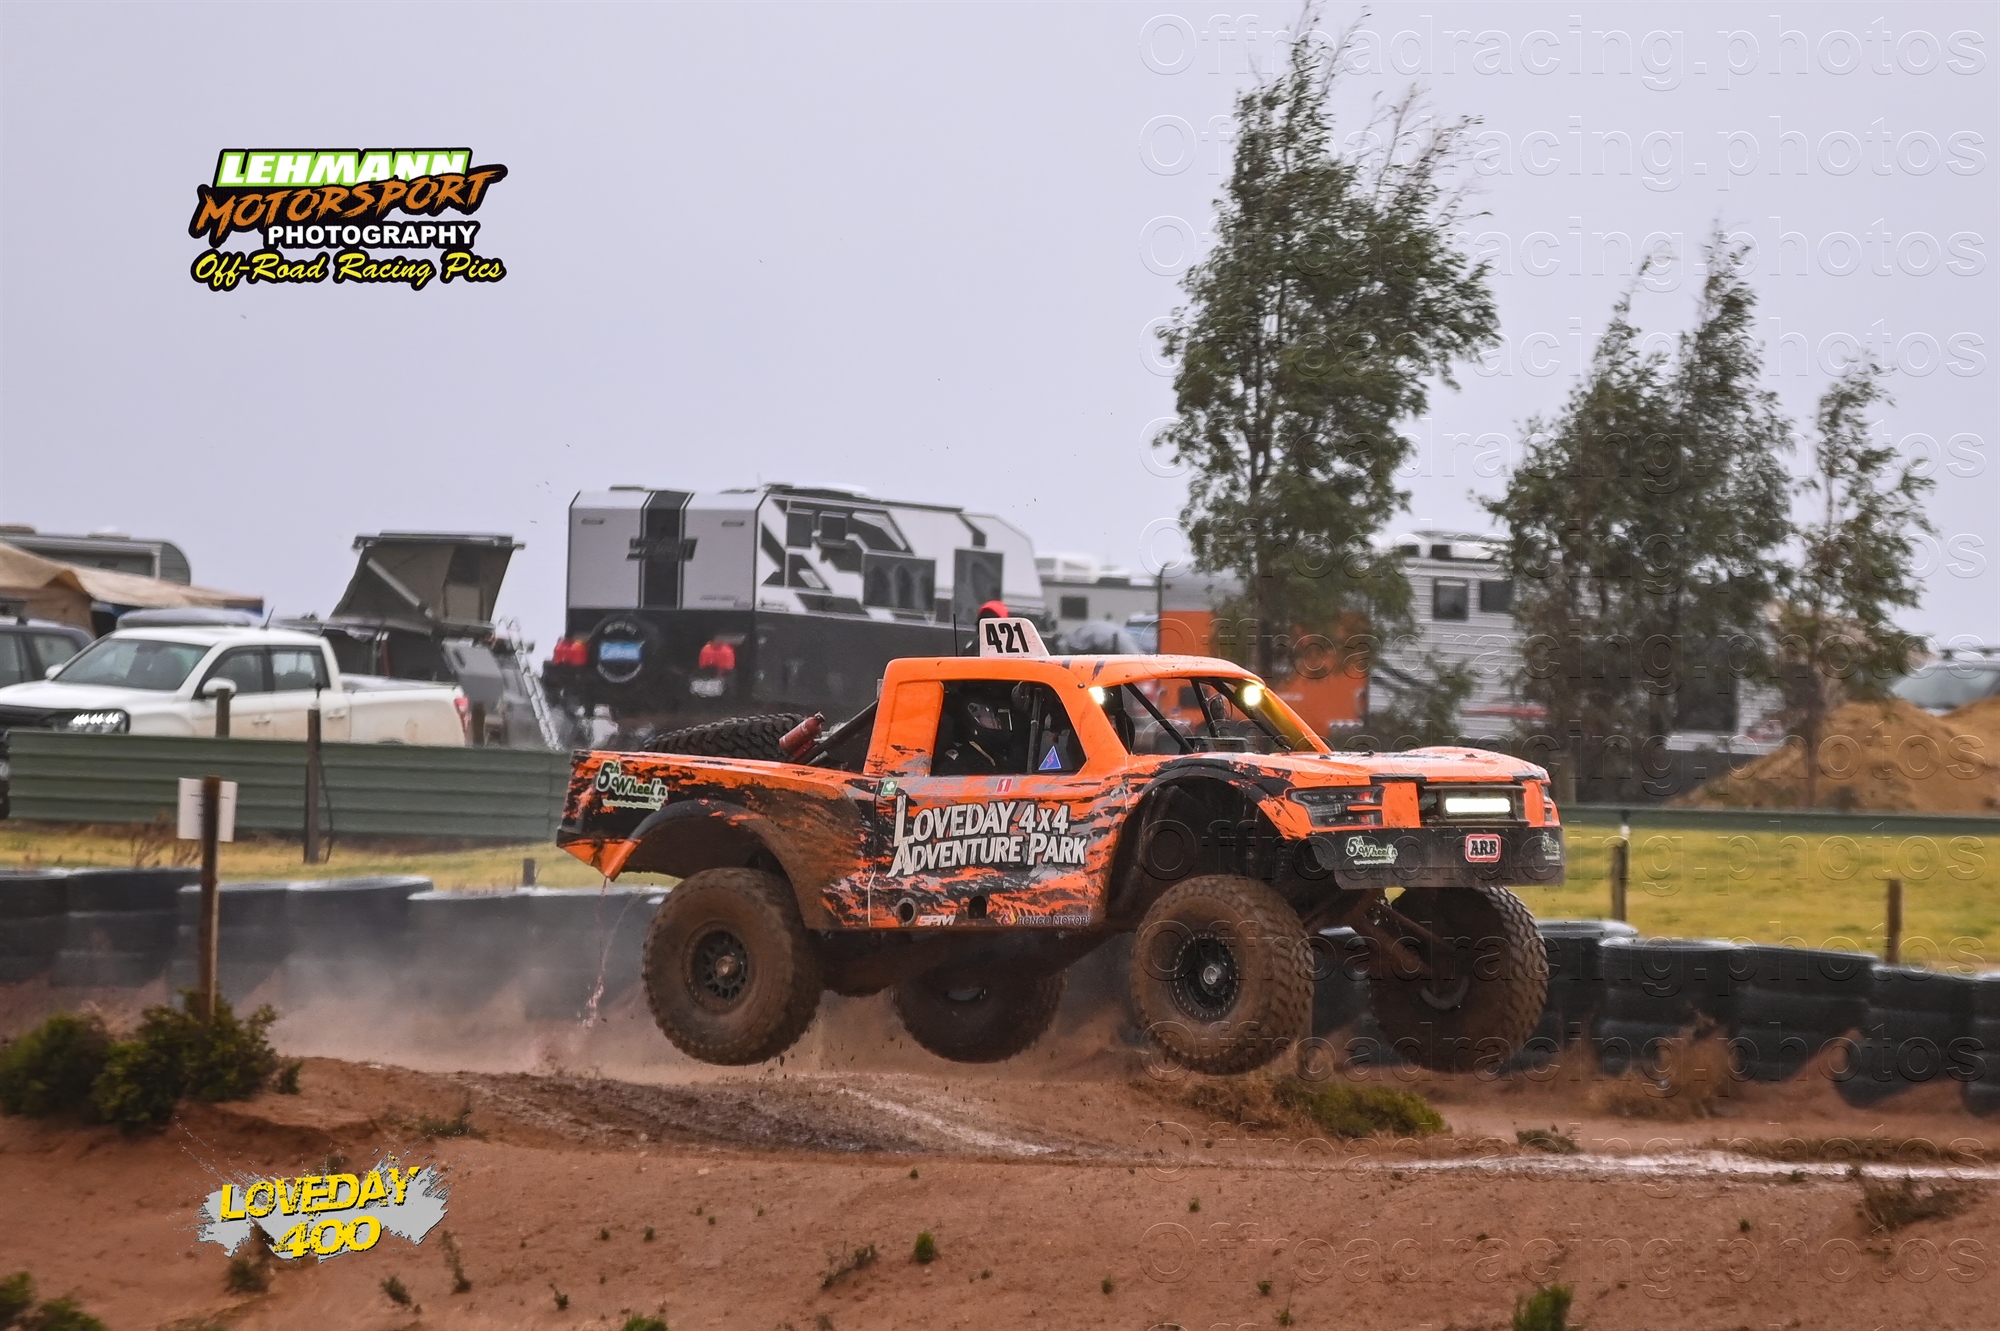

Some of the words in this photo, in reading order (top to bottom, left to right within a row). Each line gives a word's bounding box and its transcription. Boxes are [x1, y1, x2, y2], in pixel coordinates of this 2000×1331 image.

[985, 622, 1029, 653] 421
[612, 776, 667, 797] Wheel'n
[894, 795, 1017, 846] LOVEDAY
[1019, 804, 1069, 835] 4x4
[886, 836, 1024, 878] ADVENTURE
[1027, 832, 1088, 865] PARK
[1470, 840, 1498, 857] ARB
